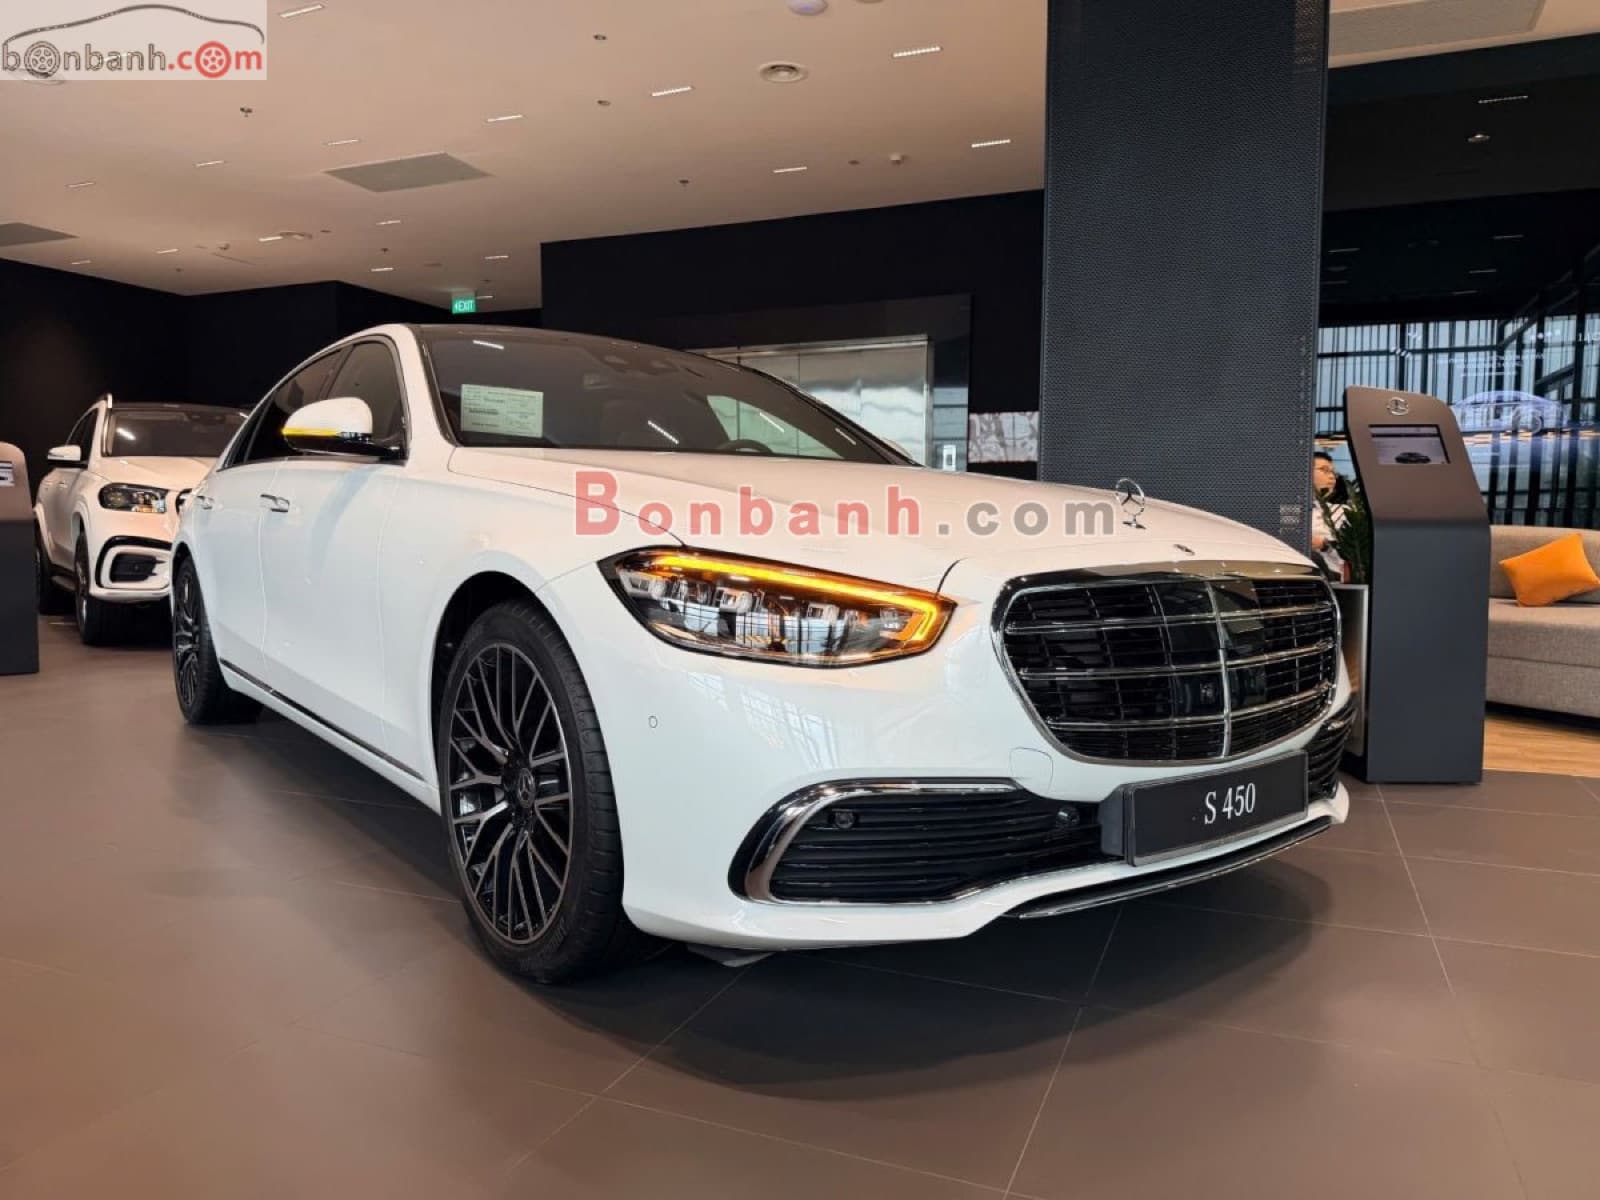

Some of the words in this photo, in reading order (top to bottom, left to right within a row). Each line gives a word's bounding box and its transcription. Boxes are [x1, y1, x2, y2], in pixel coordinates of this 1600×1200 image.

[457, 300, 475, 312] EXIT
[1204, 791, 1217, 824] S
[1222, 782, 1256, 819] 450
